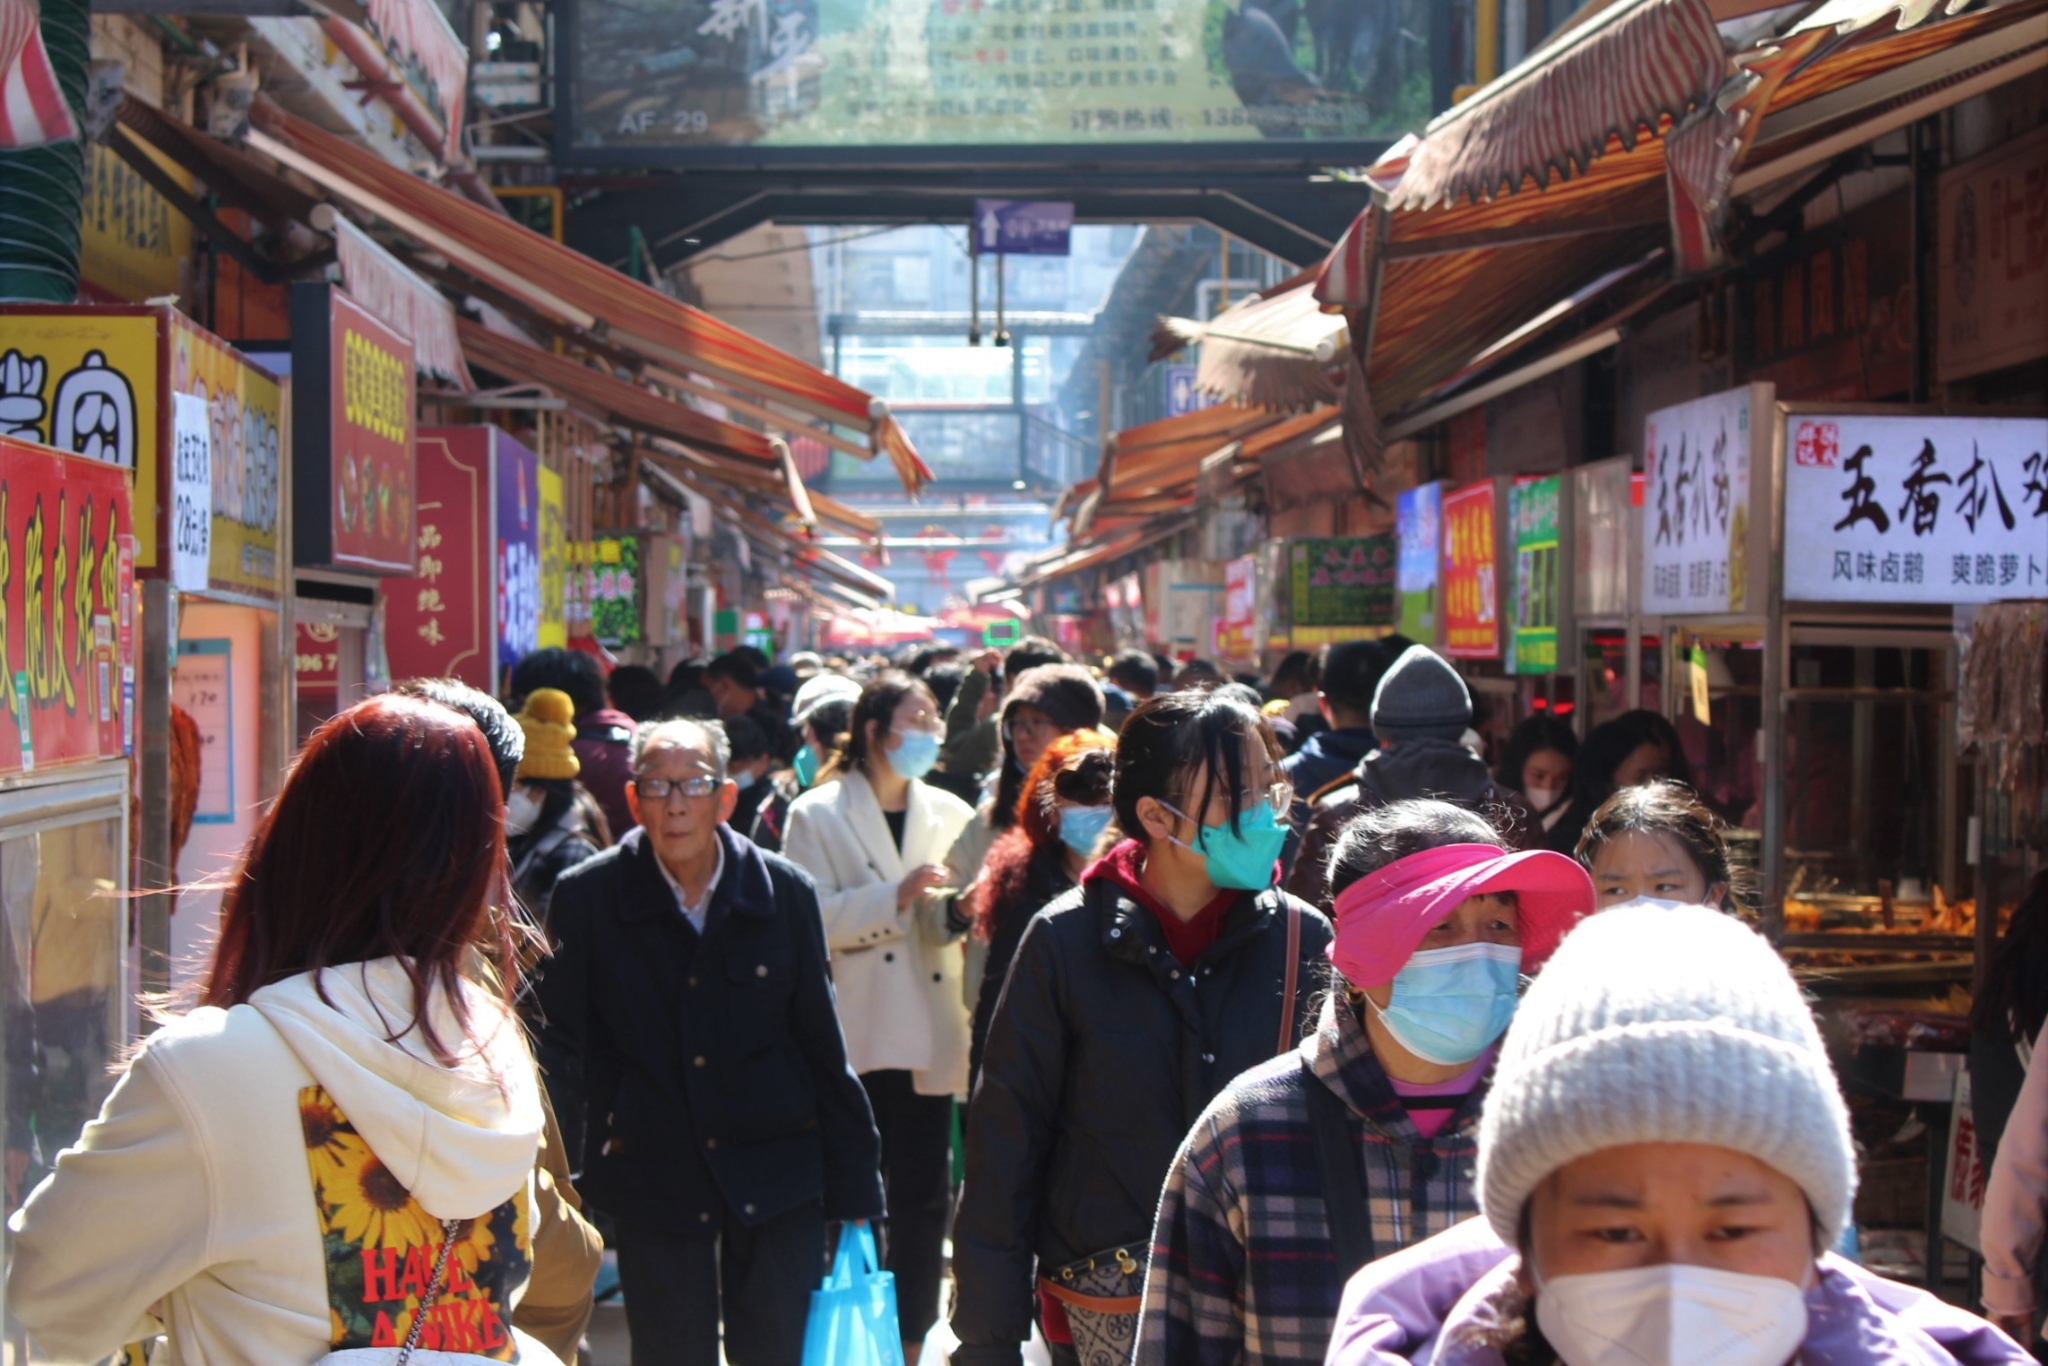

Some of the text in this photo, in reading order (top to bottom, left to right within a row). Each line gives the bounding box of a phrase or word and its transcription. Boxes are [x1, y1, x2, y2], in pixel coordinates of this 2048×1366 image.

[1832, 550, 2048, 587] 风味卤鹅 爽脆萝卜
[361, 1243, 472, 1303] HAVE
[411, 1297, 507, 1353] NIKE
